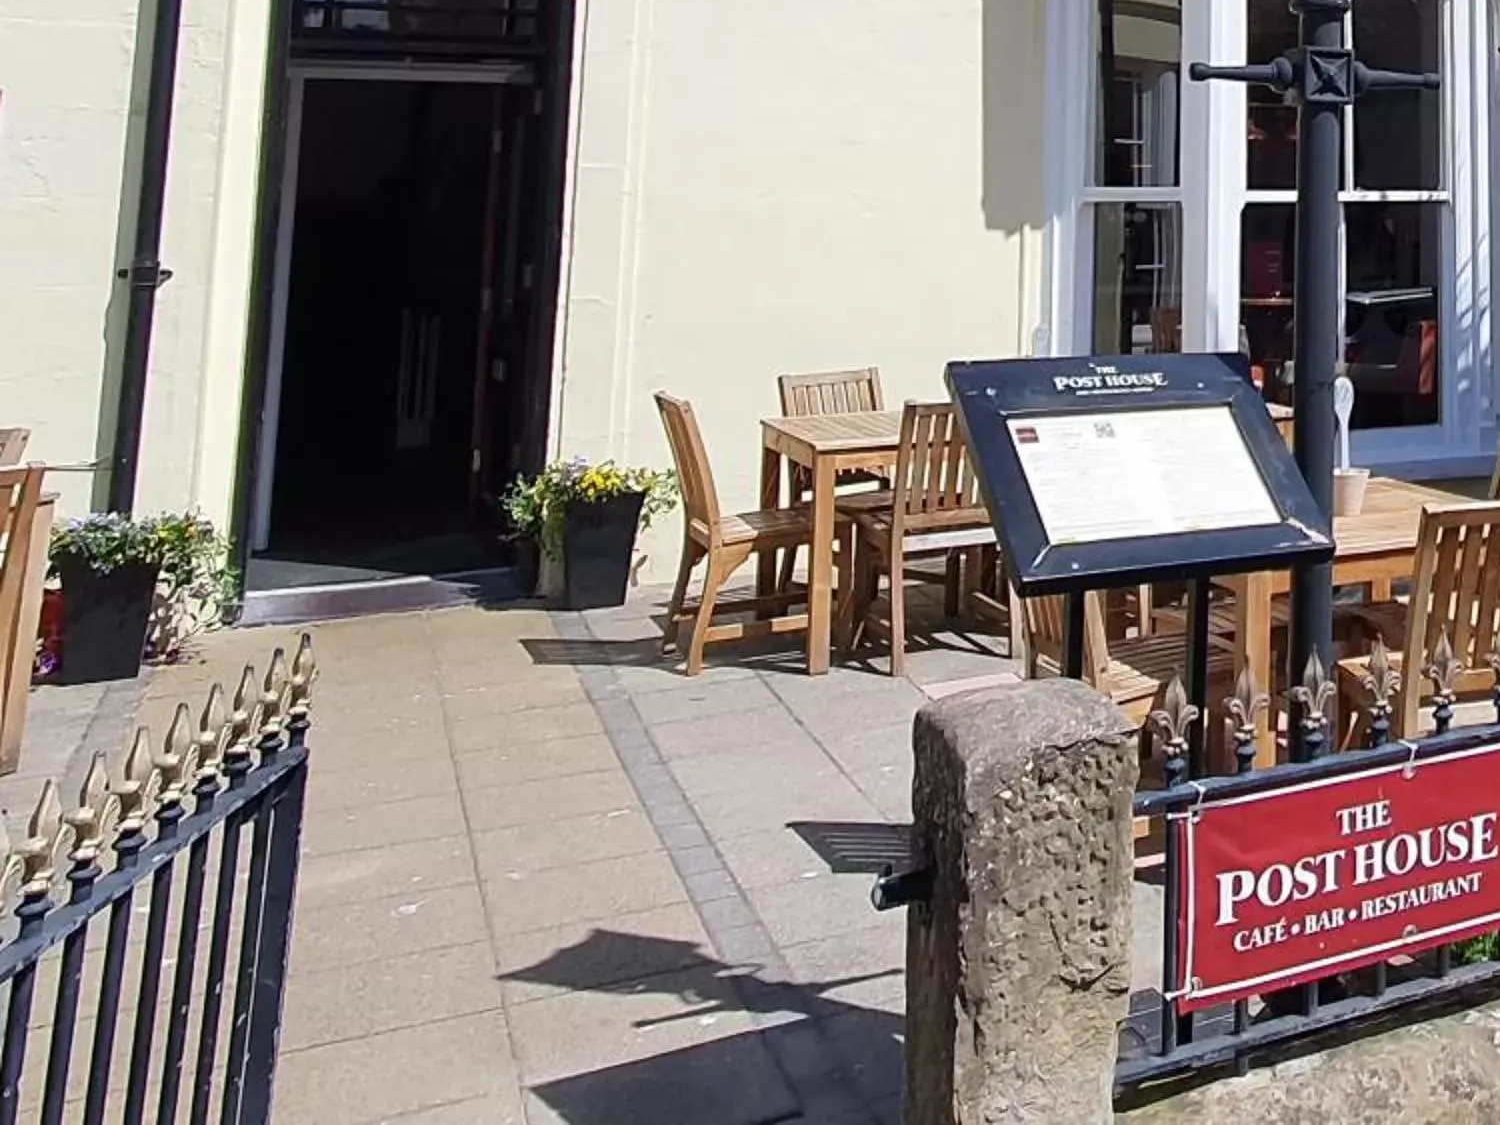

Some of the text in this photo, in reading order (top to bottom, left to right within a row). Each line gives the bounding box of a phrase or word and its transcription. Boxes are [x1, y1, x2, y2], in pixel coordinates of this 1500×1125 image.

[1053, 376, 1103, 391] POST
[1105, 372, 1169, 387] HOUSE
[1096, 366, 1119, 375] THE
[1335, 798, 1392, 836] THE
[1215, 812, 1500, 927] POST HOUSE
[1233, 871, 1484, 952] CAFÉ BAR RESTAURANT
